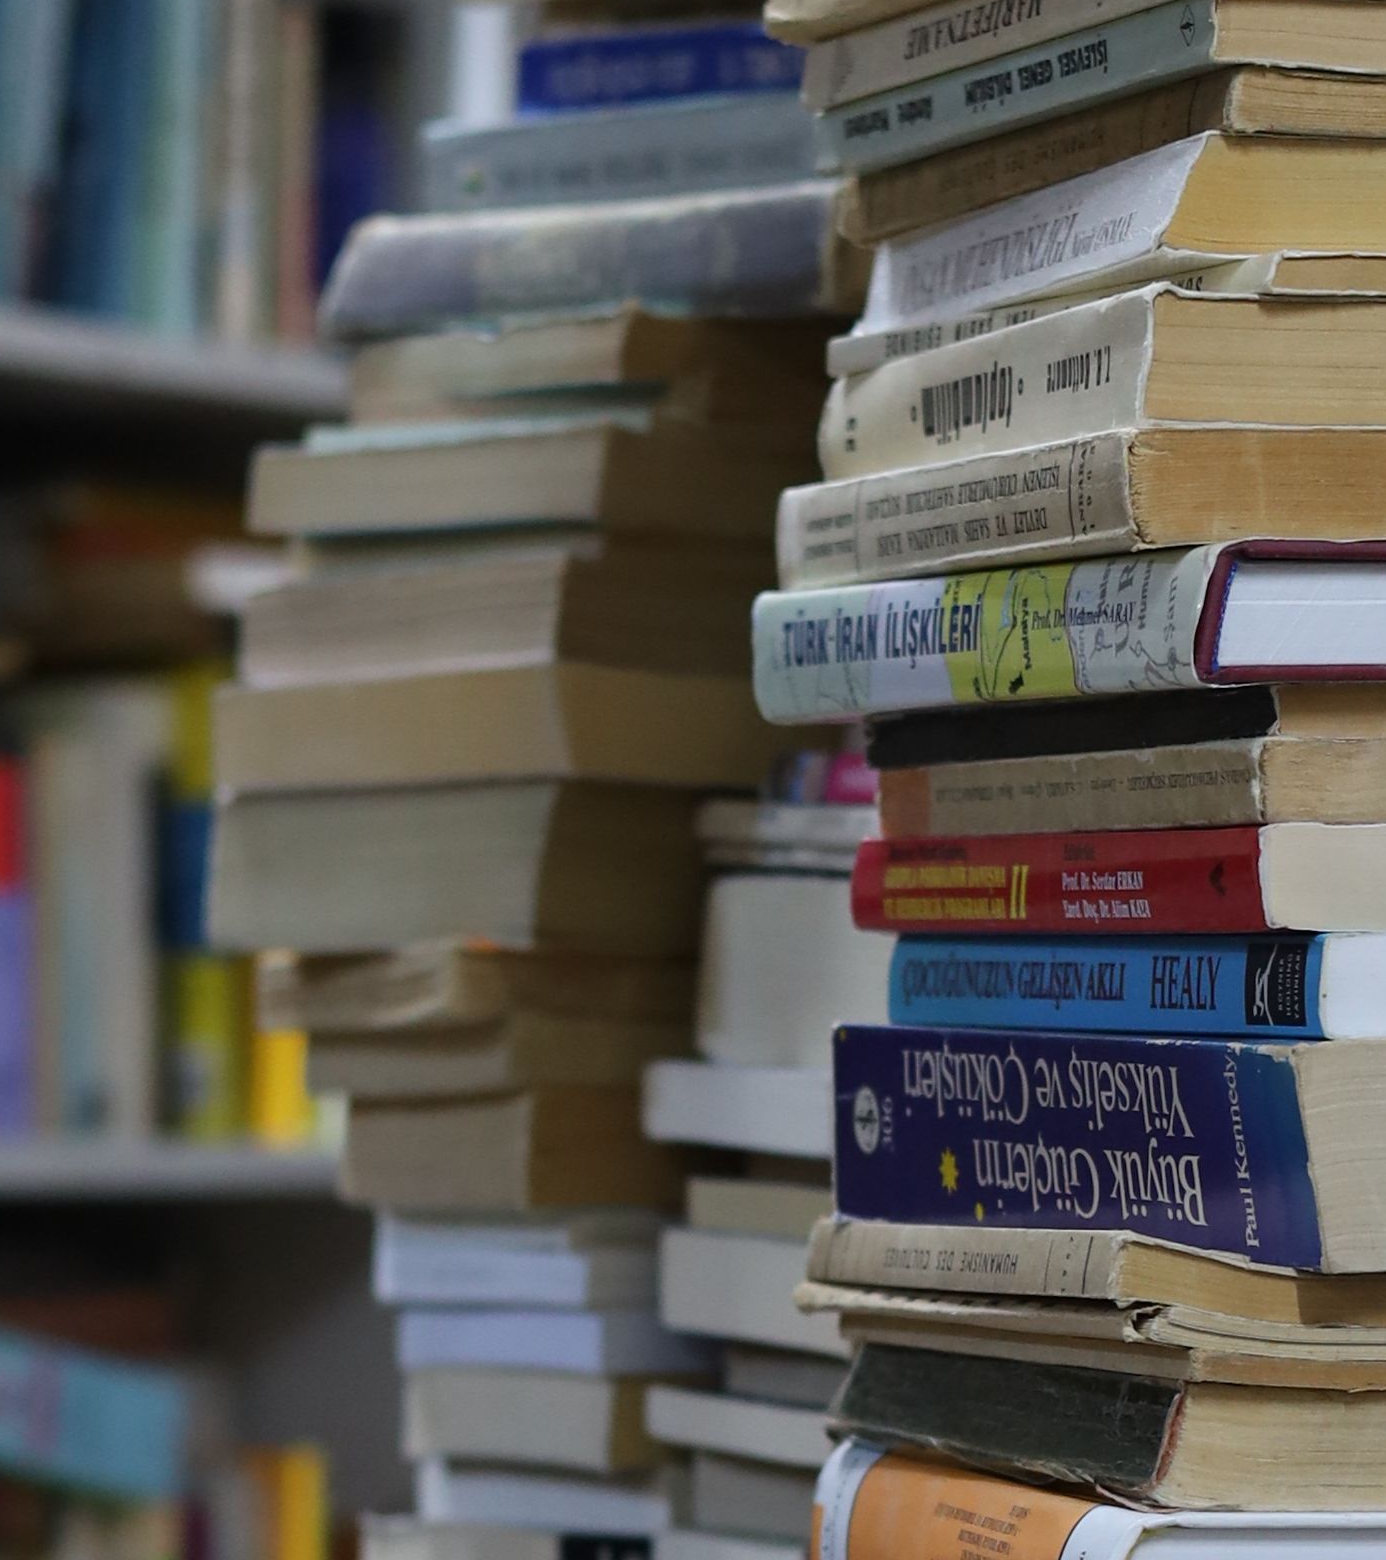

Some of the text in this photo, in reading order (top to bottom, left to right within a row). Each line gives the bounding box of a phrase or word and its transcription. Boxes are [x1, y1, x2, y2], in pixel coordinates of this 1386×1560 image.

[1018, 59, 1054, 91] GENEL
[1013, 507, 1048, 535] DEVLET
[782, 593, 982, 670] TÜRK-İRAN İLİŞKİLERİ
[1061, 871, 1078, 890] Prof.
[1117, 871, 1143, 890] ERKAN
[1017, 952, 1085, 1010] GELİŞEN
[1086, 962, 1126, 1001] AKLI
[1149, 955, 1221, 1011] HEALY
[901, 1038, 1194, 1139] Yükseliş ve Çöküşleri
[1223, 1049, 1260, 1248] Paul Kennedy
[972, 1132, 1207, 1227] Büyük Güçlerin
[935, 1251, 955, 1272] DES
[960, 1252, 1019, 1276] HUMANISME
